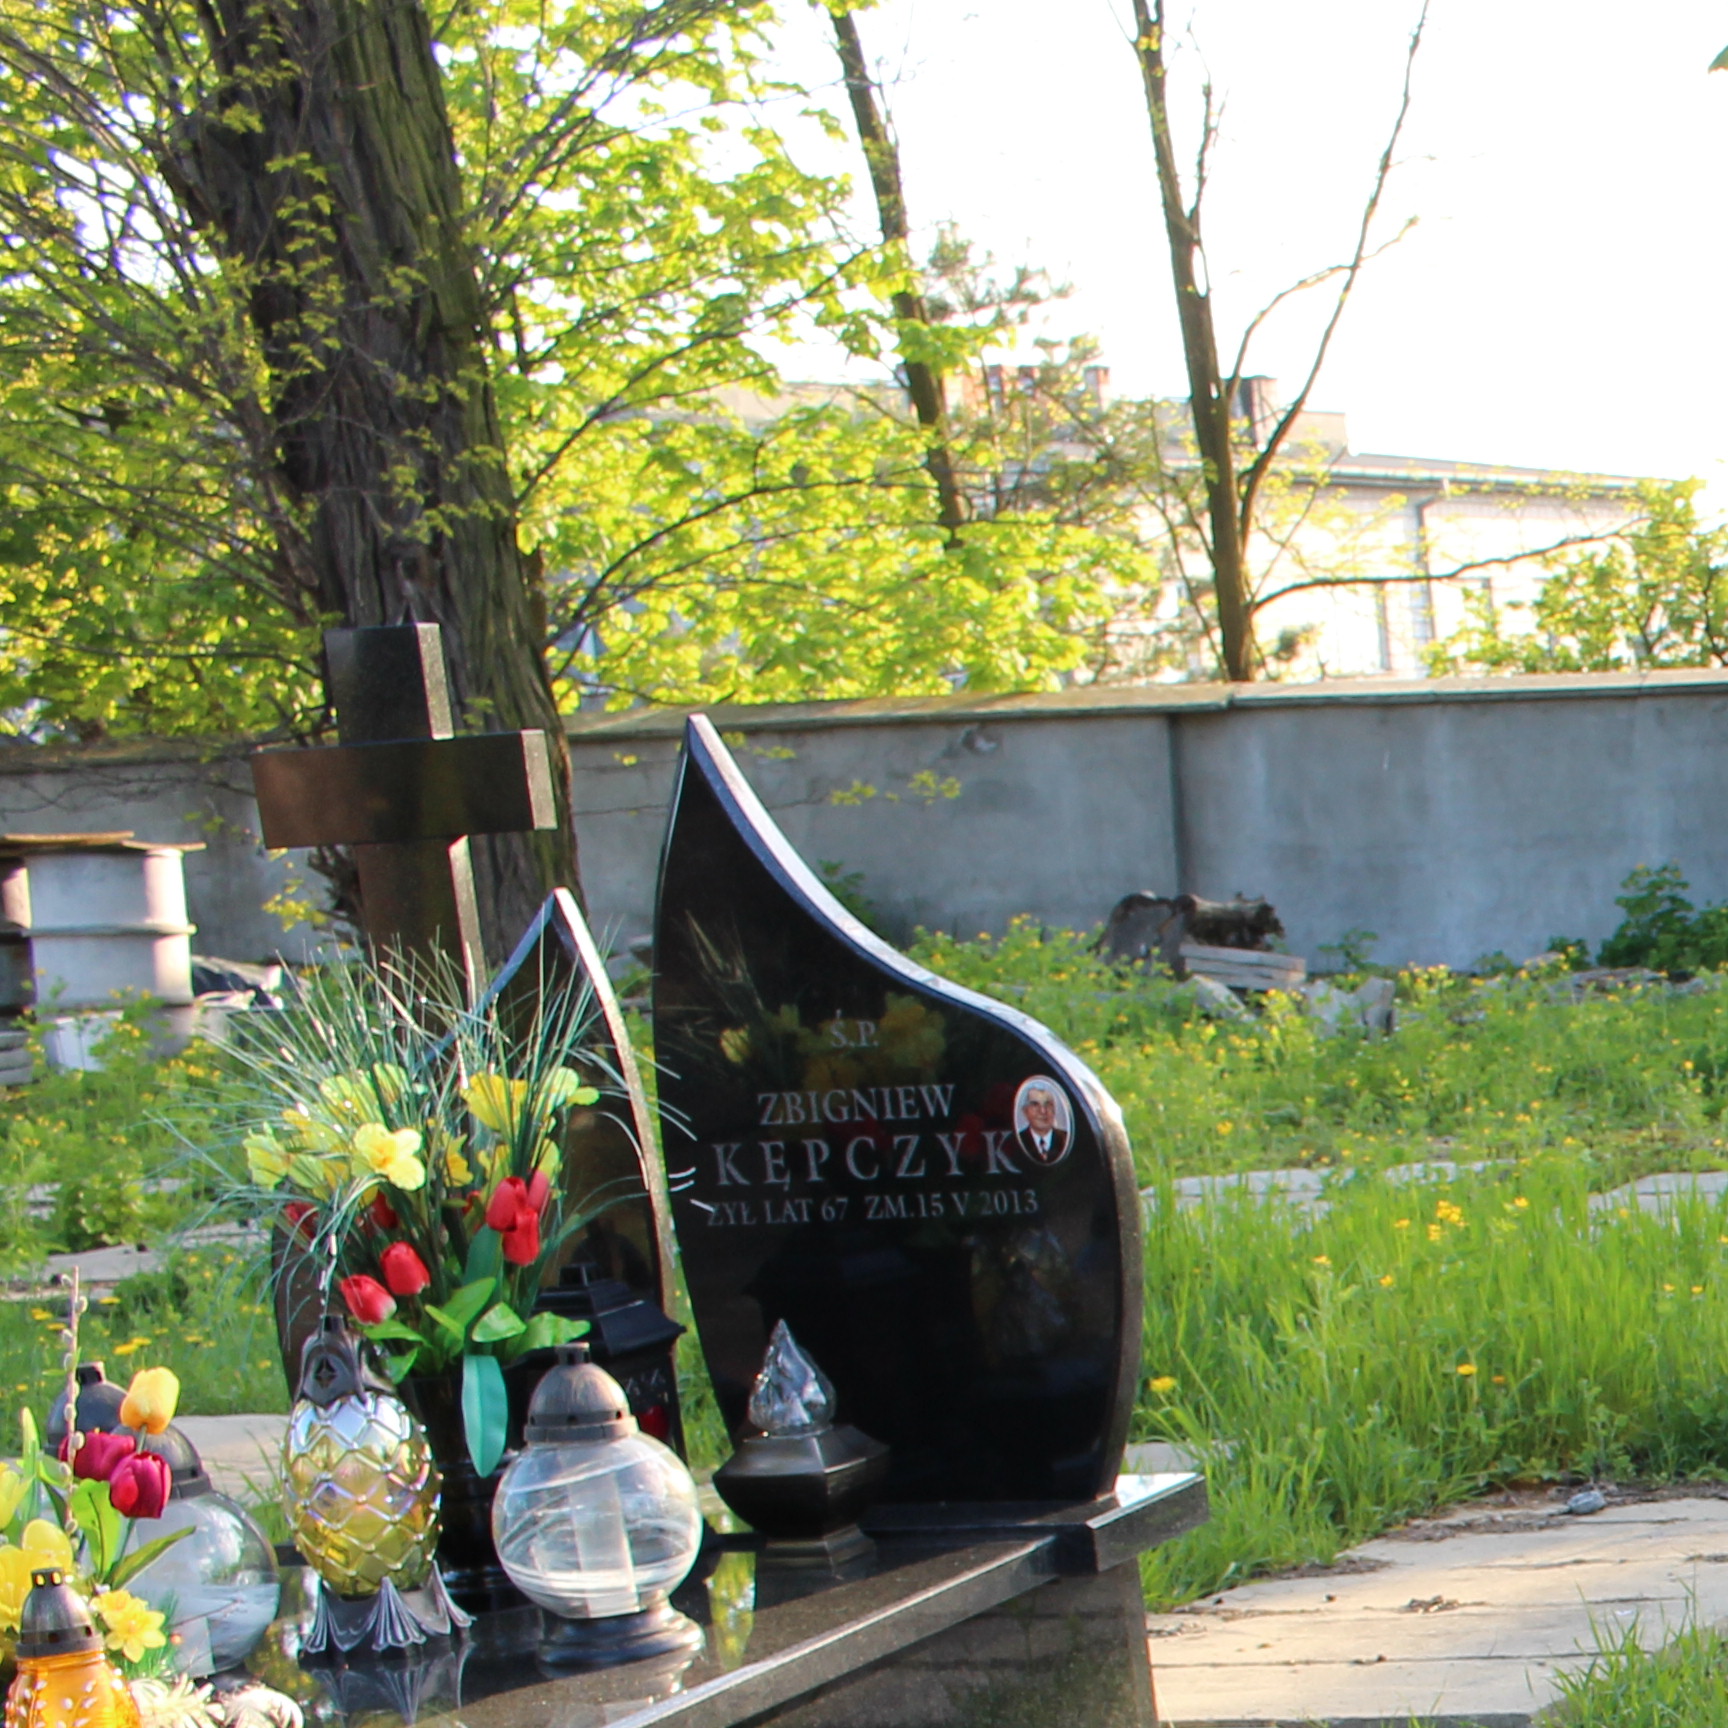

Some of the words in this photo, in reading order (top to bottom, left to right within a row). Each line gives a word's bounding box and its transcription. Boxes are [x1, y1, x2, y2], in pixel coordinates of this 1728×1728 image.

[756, 1083, 956, 1126] ZBIGNIEW
[711, 1130, 1023, 1192] KĘPCZYK
[763, 1198, 814, 1225] LAT
[820, 1197, 850, 1223] 67
[951, 1191, 972, 1217] V
[979, 1188, 1041, 1216] 2013
